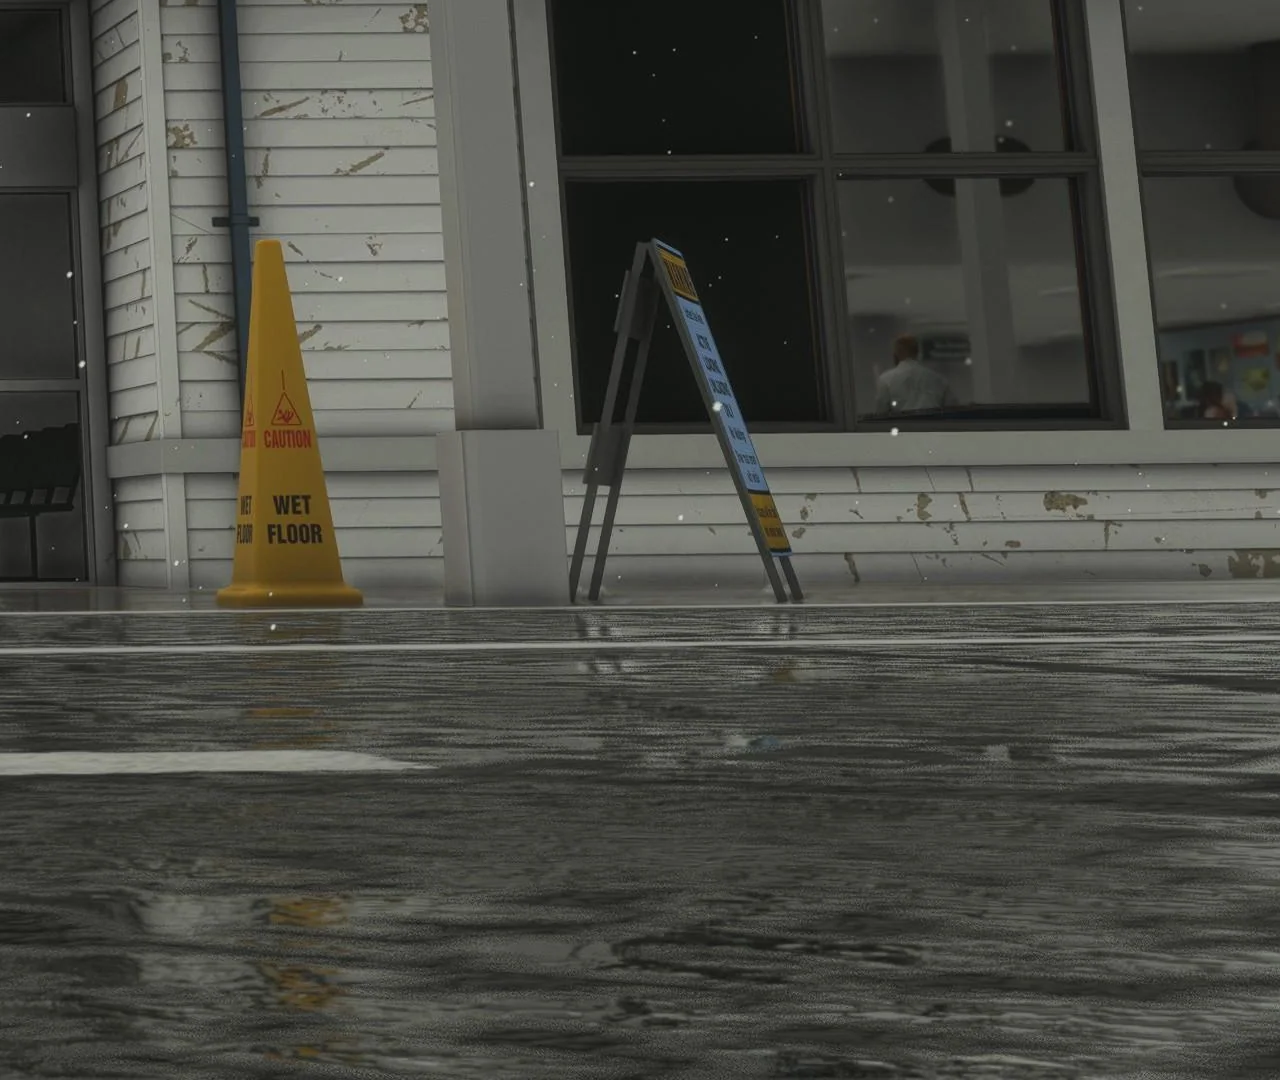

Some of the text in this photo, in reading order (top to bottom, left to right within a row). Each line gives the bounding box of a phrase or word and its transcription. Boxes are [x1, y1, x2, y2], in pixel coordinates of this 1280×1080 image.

[264, 429, 312, 448] CAUTION
[272, 494, 311, 515] WET
[267, 523, 323, 544] FLOOR
